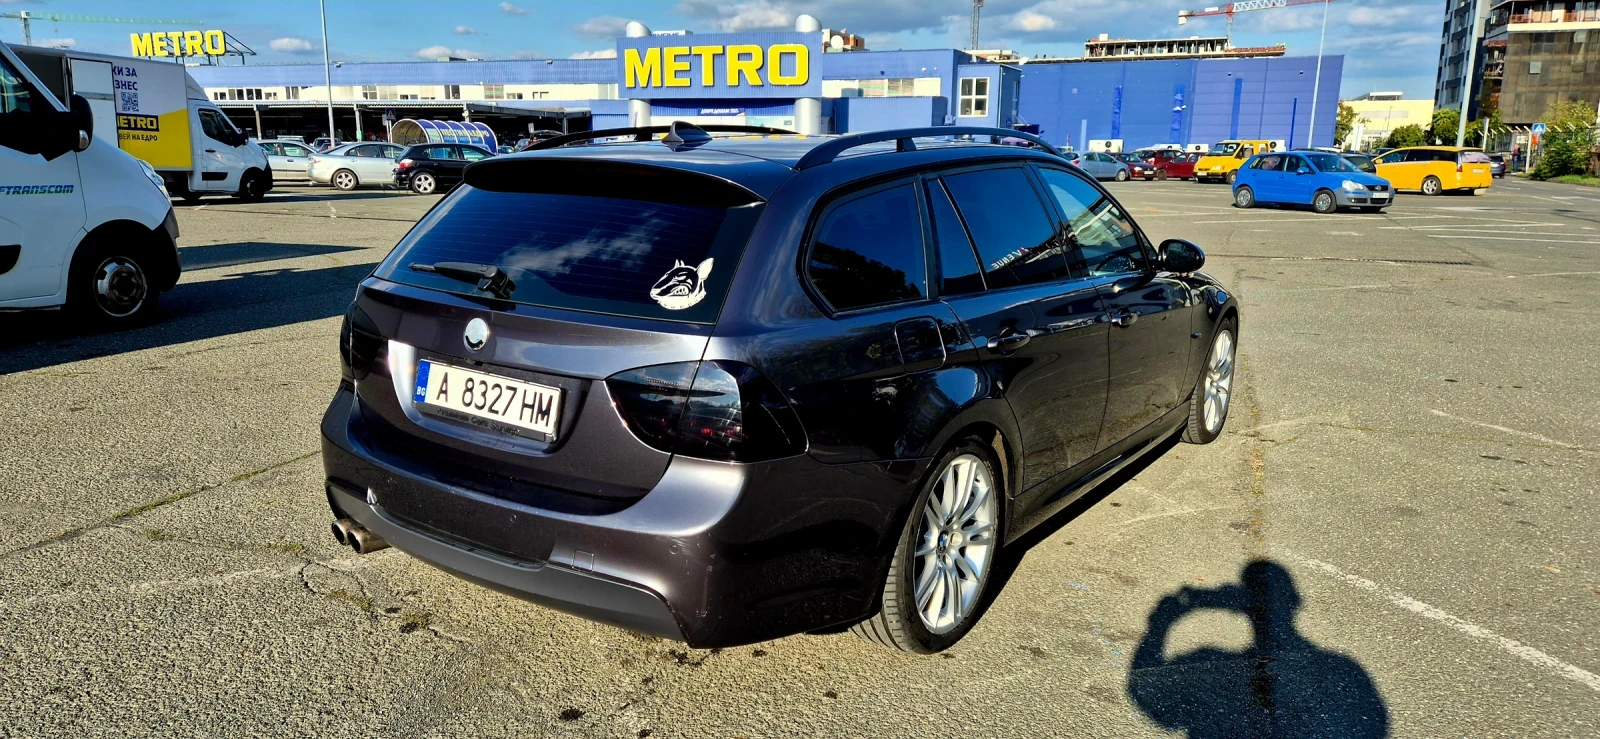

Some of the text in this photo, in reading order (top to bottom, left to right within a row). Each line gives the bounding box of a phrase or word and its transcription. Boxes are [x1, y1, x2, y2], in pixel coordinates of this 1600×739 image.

[130, 29, 226, 57] METRO
[125, 67, 138, 77] ЗА
[624, 43, 810, 89] METRO
[141, 134, 158, 142] ЕДРО
[416, 386, 426, 396] BG
[436, 372, 553, 427] A 8327 HM
